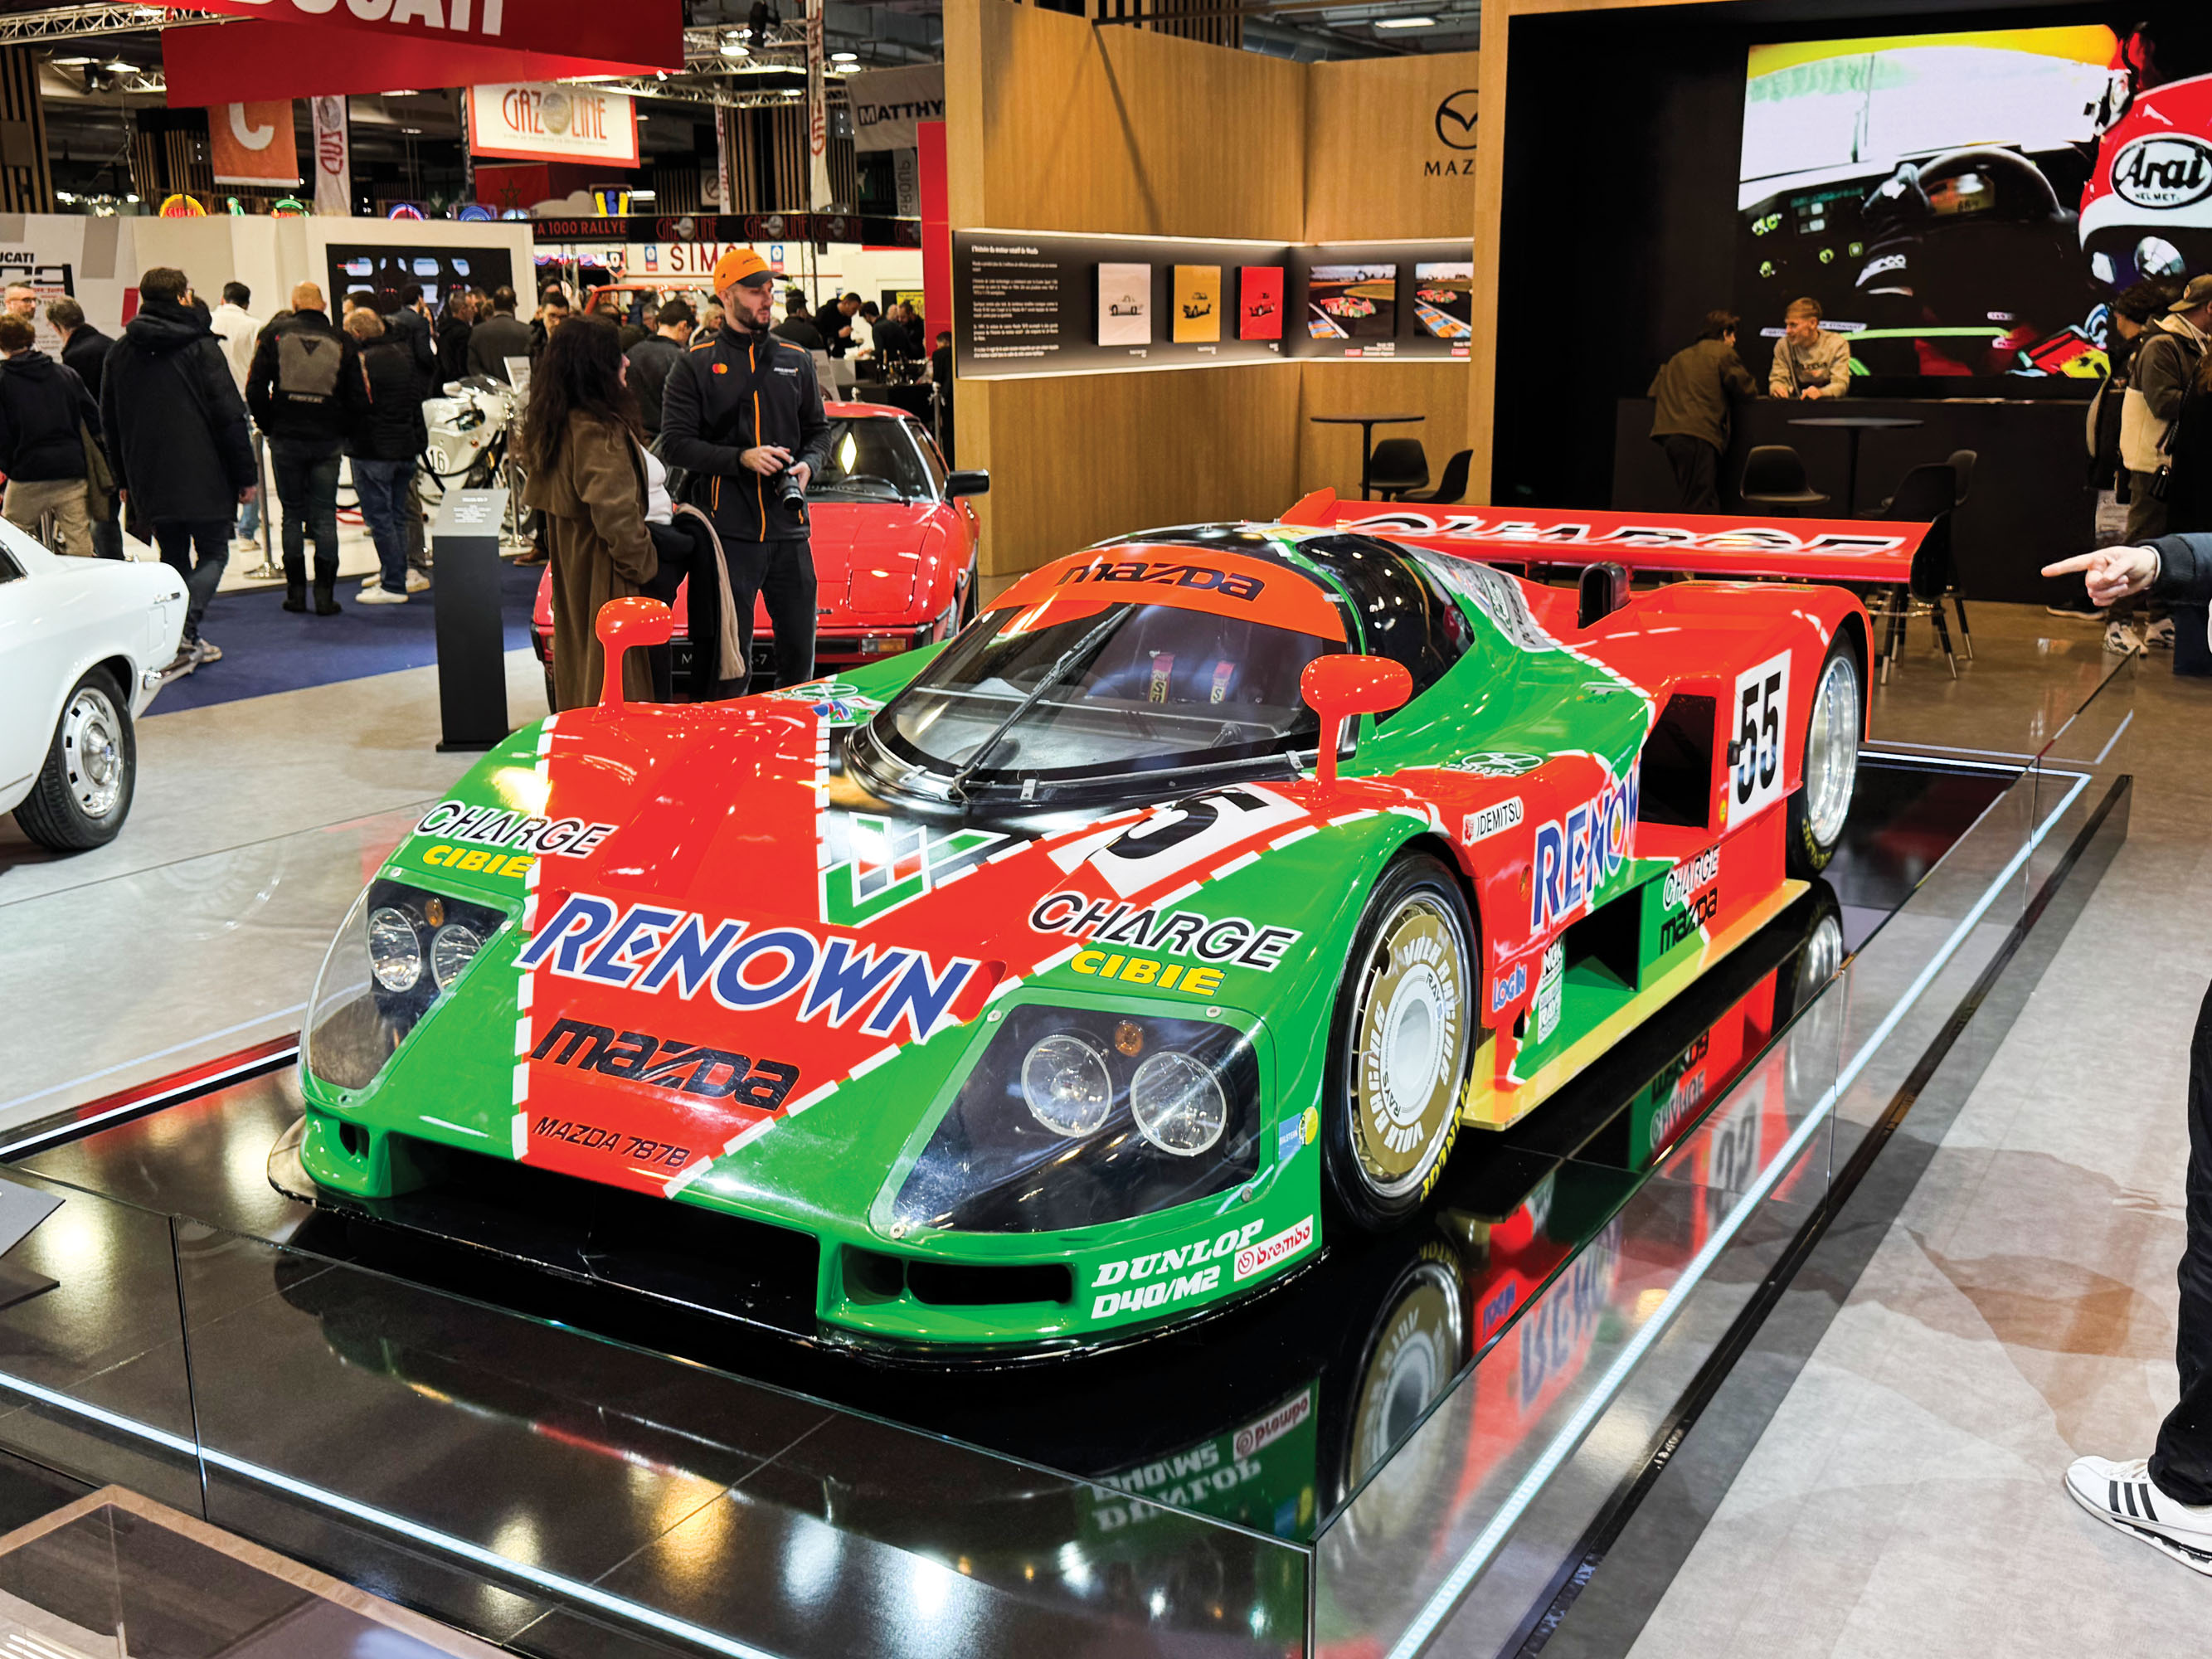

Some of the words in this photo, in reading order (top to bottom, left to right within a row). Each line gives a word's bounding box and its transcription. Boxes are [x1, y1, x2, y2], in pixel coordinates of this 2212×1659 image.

[2117, 145, 2206, 189] Arai
[549, 221, 578, 236] 1000
[581, 220, 627, 235] RALLYE
[1738, 670, 1782, 805] 55
[414, 800, 619, 859] CHARGE
[1476, 799, 1522, 837] IDEMITSU
[1663, 843, 1720, 911] CHARGE
[1028, 891, 1304, 973] CHARGE
[511, 892, 982, 1045] RENOWN
[1492, 961, 1527, 1013] LOGIN
[532, 1116, 622, 1152] MAZDA
[621, 1136, 691, 1169] 787B
[1091, 1218, 1264, 1287] DUNLOP
[1256, 1224, 1310, 1266] brembo
[1091, 1265, 1222, 1320] D40/M2
